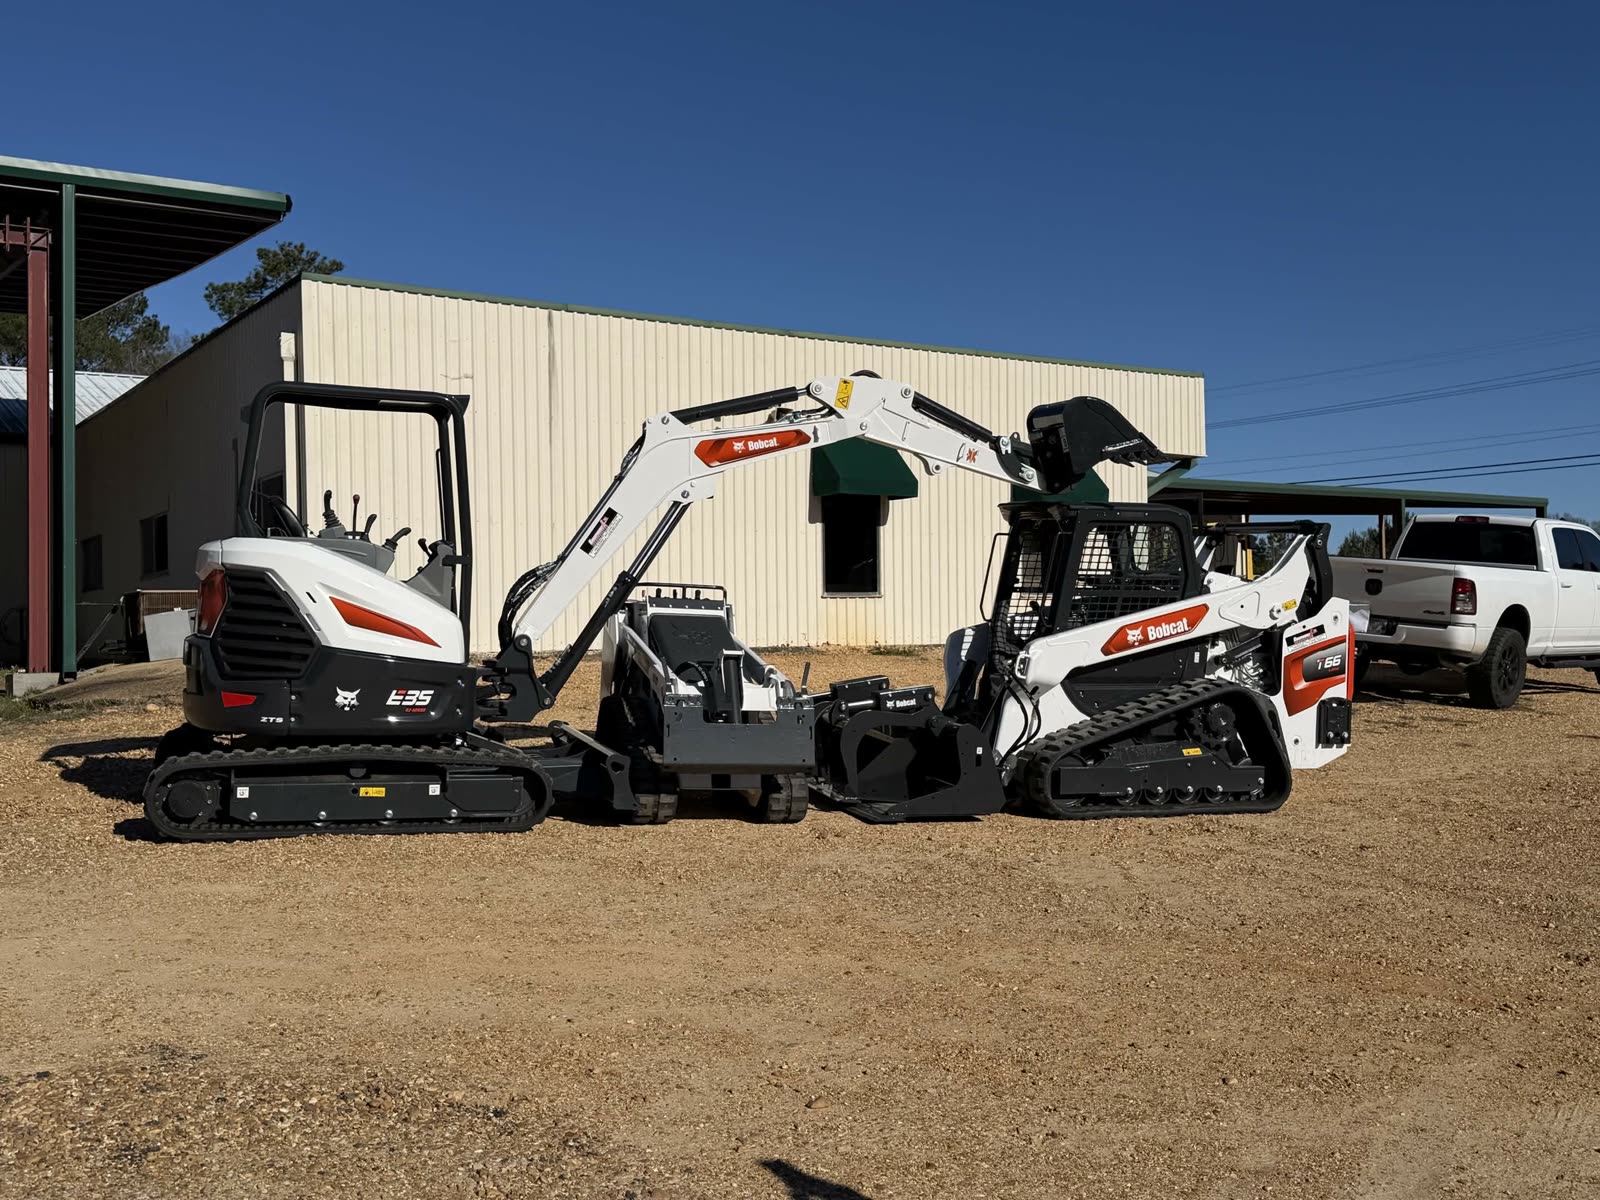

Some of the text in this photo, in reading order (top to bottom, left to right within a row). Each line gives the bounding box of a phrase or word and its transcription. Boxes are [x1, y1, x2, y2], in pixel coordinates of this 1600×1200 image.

[747, 437, 777, 451] Bobcat
[1147, 617, 1189, 641] Bobcat
[1316, 654, 1342, 670] T66
[386, 689, 434, 705] E35
[895, 698, 916, 708] Bobcat
